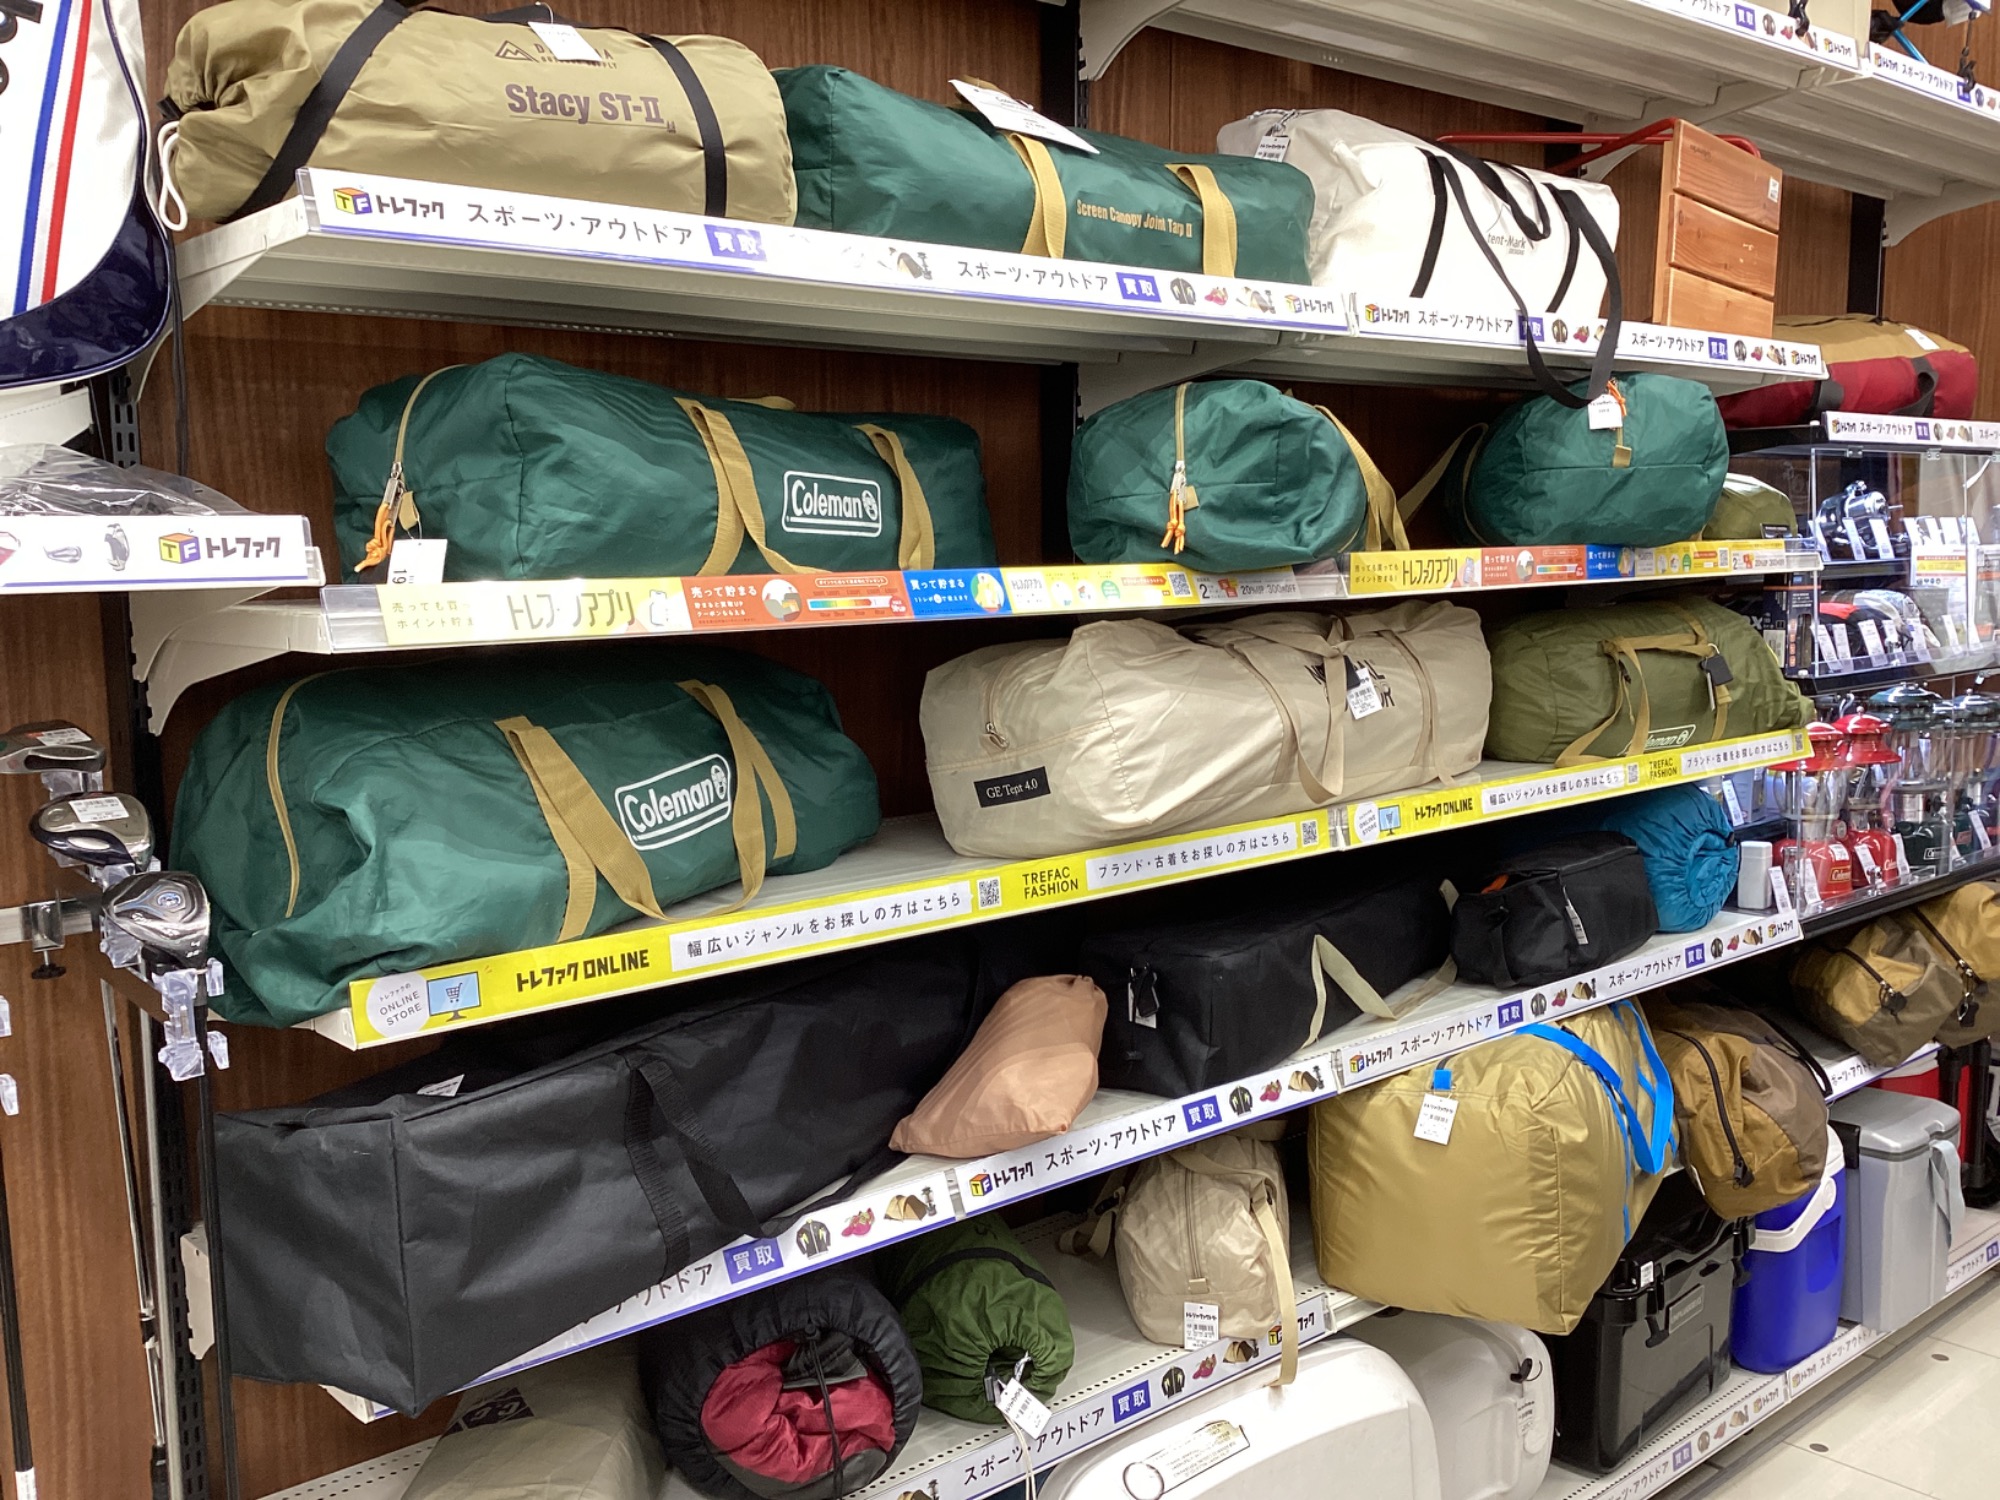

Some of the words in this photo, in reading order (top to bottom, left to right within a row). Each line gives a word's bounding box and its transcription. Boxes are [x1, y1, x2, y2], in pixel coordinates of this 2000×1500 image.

[504, 84, 590, 124] Stacy
[599, 92, 665, 124] ST-II
[376, 195, 445, 220] トレファク
[1076, 199, 1108, 221] Screen
[1109, 207, 1142, 232] Canopy
[1143, 214, 1167, 232] Joint
[1167, 217, 1185, 237] Tarp
[467, 203, 693, 245] スポーツ・アウトドア
[957, 260, 1109, 291] スポーツ・アウトドア
[1122, 277, 1156, 298] 買取
[1303, 299, 1335, 315] トレファク
[1381, 307, 1410, 325] トレファク
[1417, 310, 1514, 334] スポーツ・アウトドア
[1631, 332, 1705, 352] スポーツ・アウトドア
[791, 479, 863, 519] Coleman
[206, 536, 281, 559] トレファク
[1402, 556, 1459, 586] トレファクアプリ
[690, 584, 758, 600] 売って貯まる
[909, 578, 965, 591] 買って貯まる
[1650, 757, 1674, 770] TREFAC
[1650, 767, 1678, 780] FASHION
[986, 786, 1003, 799] GE
[1024, 777, 1039, 790] 4.0
[1489, 773, 1620, 807] 幅広いジャンルをお探しの方はこちら
[623, 778, 715, 833] Coleman
[1414, 802, 1442, 821] トレファク
[1443, 798, 1473, 816] ONLINE
[1098, 831, 1291, 879] ブランド・古着をお探しの方はこちら
[1022, 866, 1071, 887] TREFAC
[1023, 878, 1079, 900] FASHION
[686, 892, 962, 958] 幅広いジャンルをお探しの方はこちら
[1687, 947, 1705, 965] 買取
[516, 962, 579, 992] トレファク
[583, 949, 650, 980] ONLINE
[1608, 954, 1682, 988] スポーツ・アウトドア
[379, 990, 421, 1016] ONLINE
[387, 1003, 422, 1027] STORE
[1501, 1005, 1520, 1023] 買取
[1400, 1013, 1493, 1056] スポーツ・アウトドア
[1365, 1046, 1393, 1068] トレファク
[1187, 1102, 1217, 1126] 買取
[1045, 1114, 1177, 1171] スポーツ・アウトドア
[993, 1161, 1034, 1189] トレファク
[732, 1244, 776, 1275] 買取
[1117, 1391, 1147, 1416] 買取
[963, 1406, 1105, 1486] スポーツ・アウトドア
